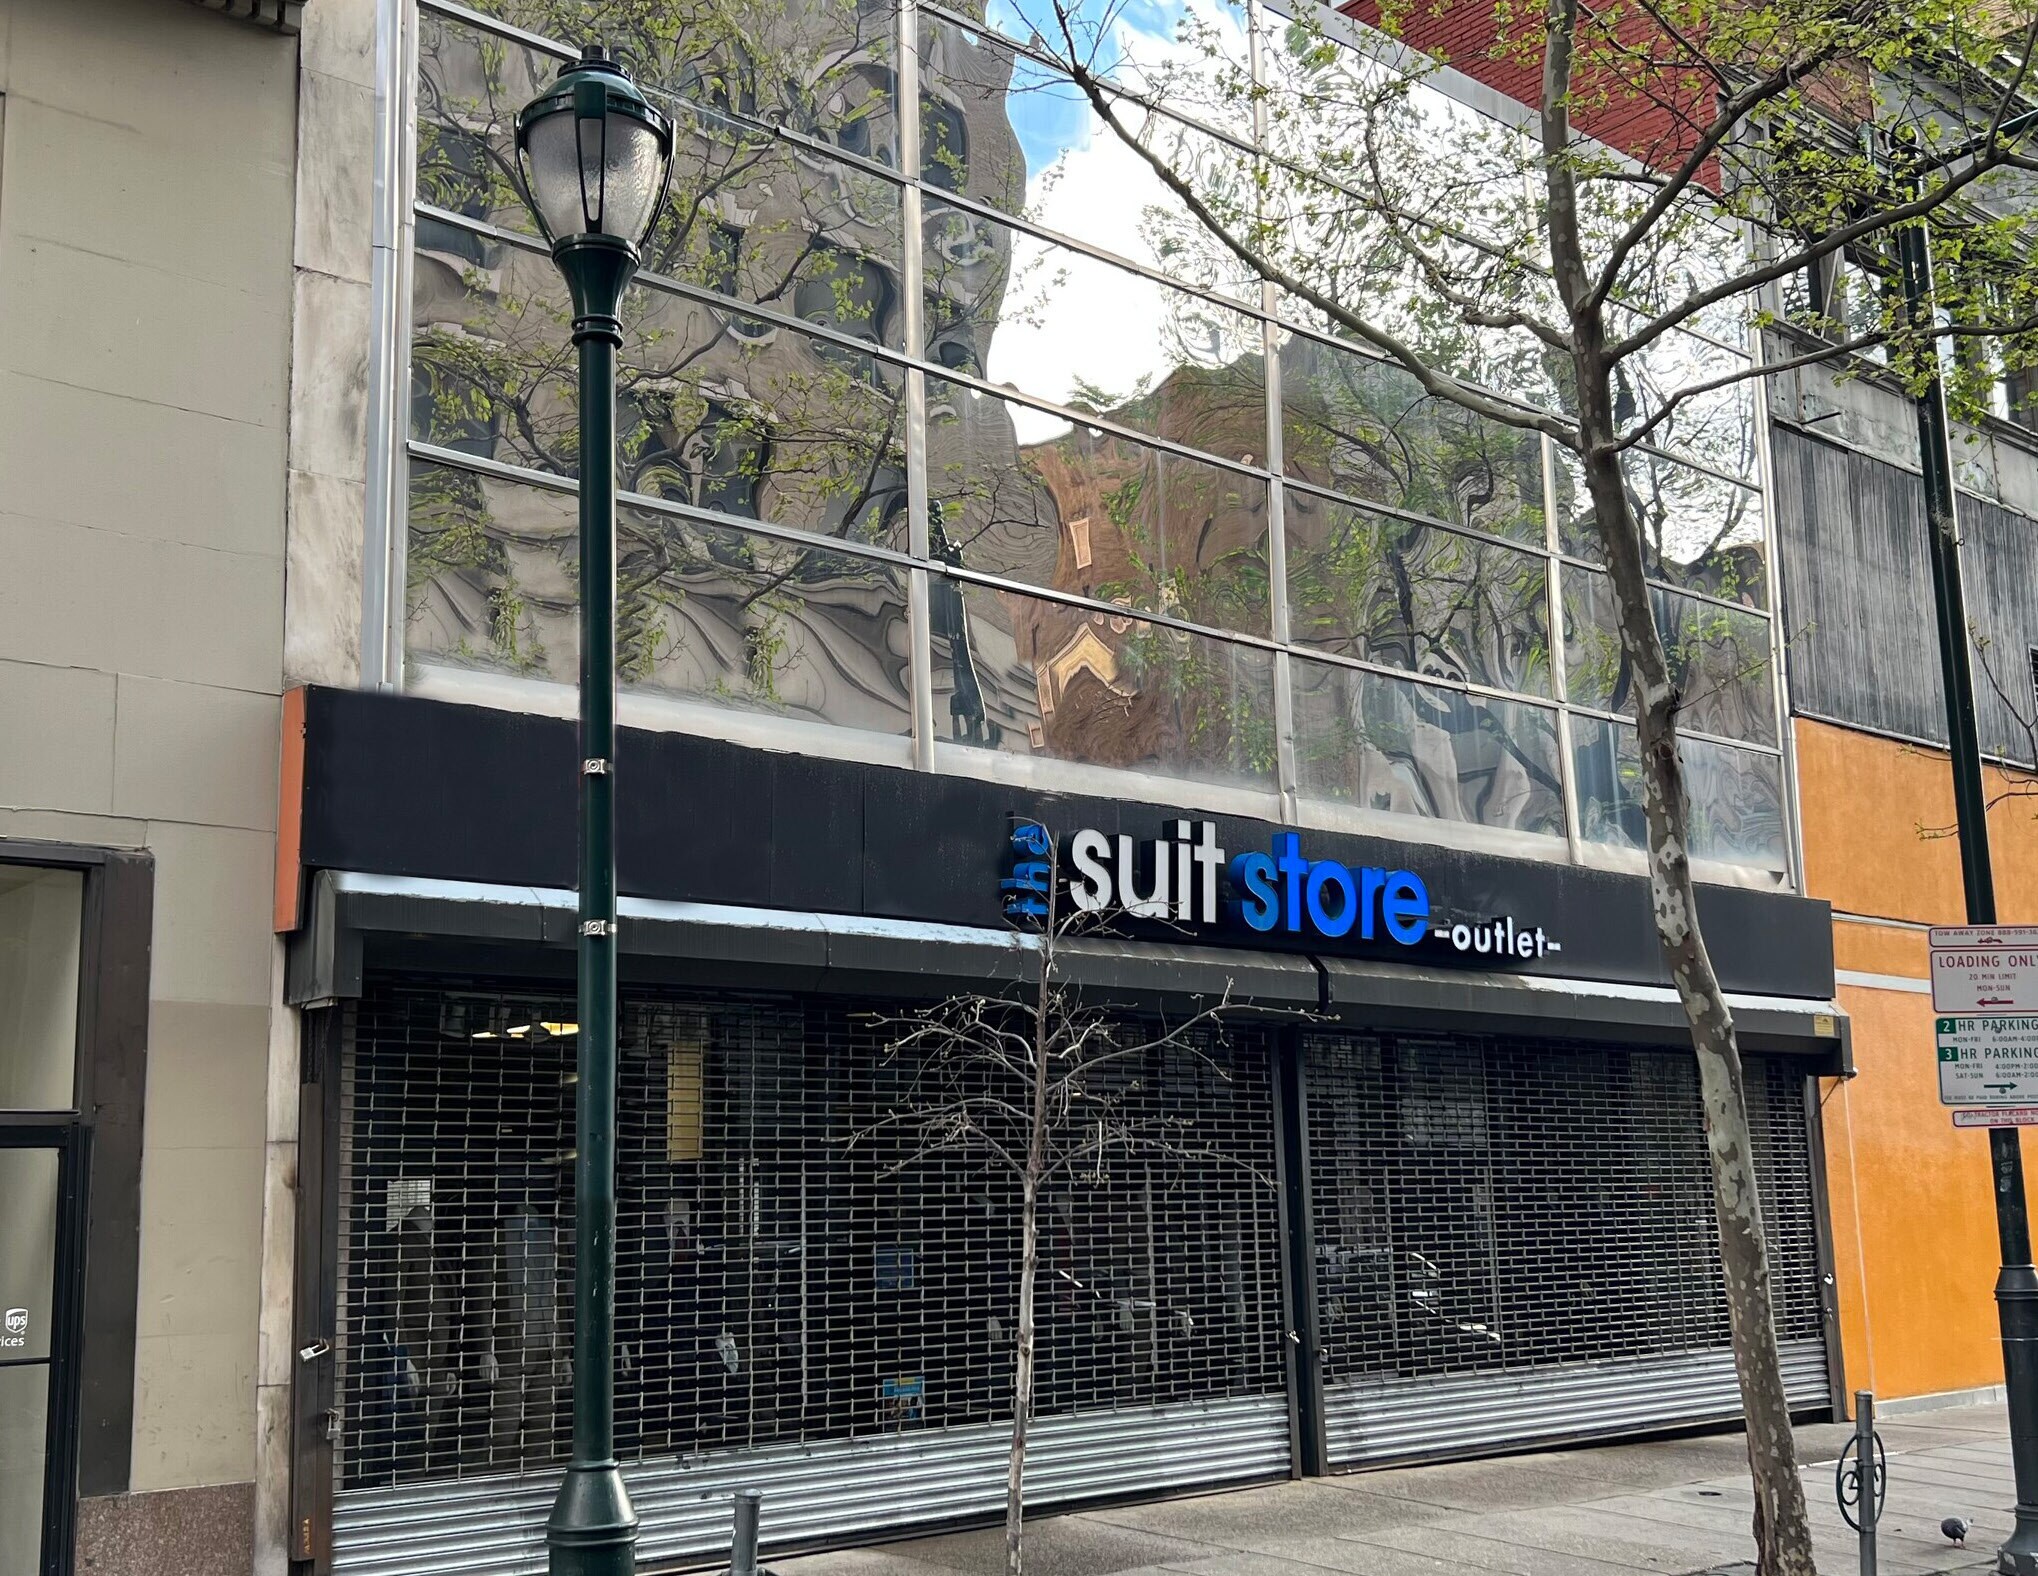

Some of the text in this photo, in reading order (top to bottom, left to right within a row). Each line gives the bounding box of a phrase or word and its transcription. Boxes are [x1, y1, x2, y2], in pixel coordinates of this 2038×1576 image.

[1006, 825, 1050, 915] the
[1069, 819, 1226, 924] suit
[1235, 831, 1430, 945] store
[1939, 955, 2038, 968] LOADING ONL
[1976, 984, 2011, 992] MON-SUN
[1943, 1019, 2038, 1032] 2 HR PARKING
[1945, 1048, 1952, 1060] 3
[1960, 1048, 1977, 1060] HR
[7, 1315, 26, 1330] ups
[0, 1336, 25, 1347] ices
